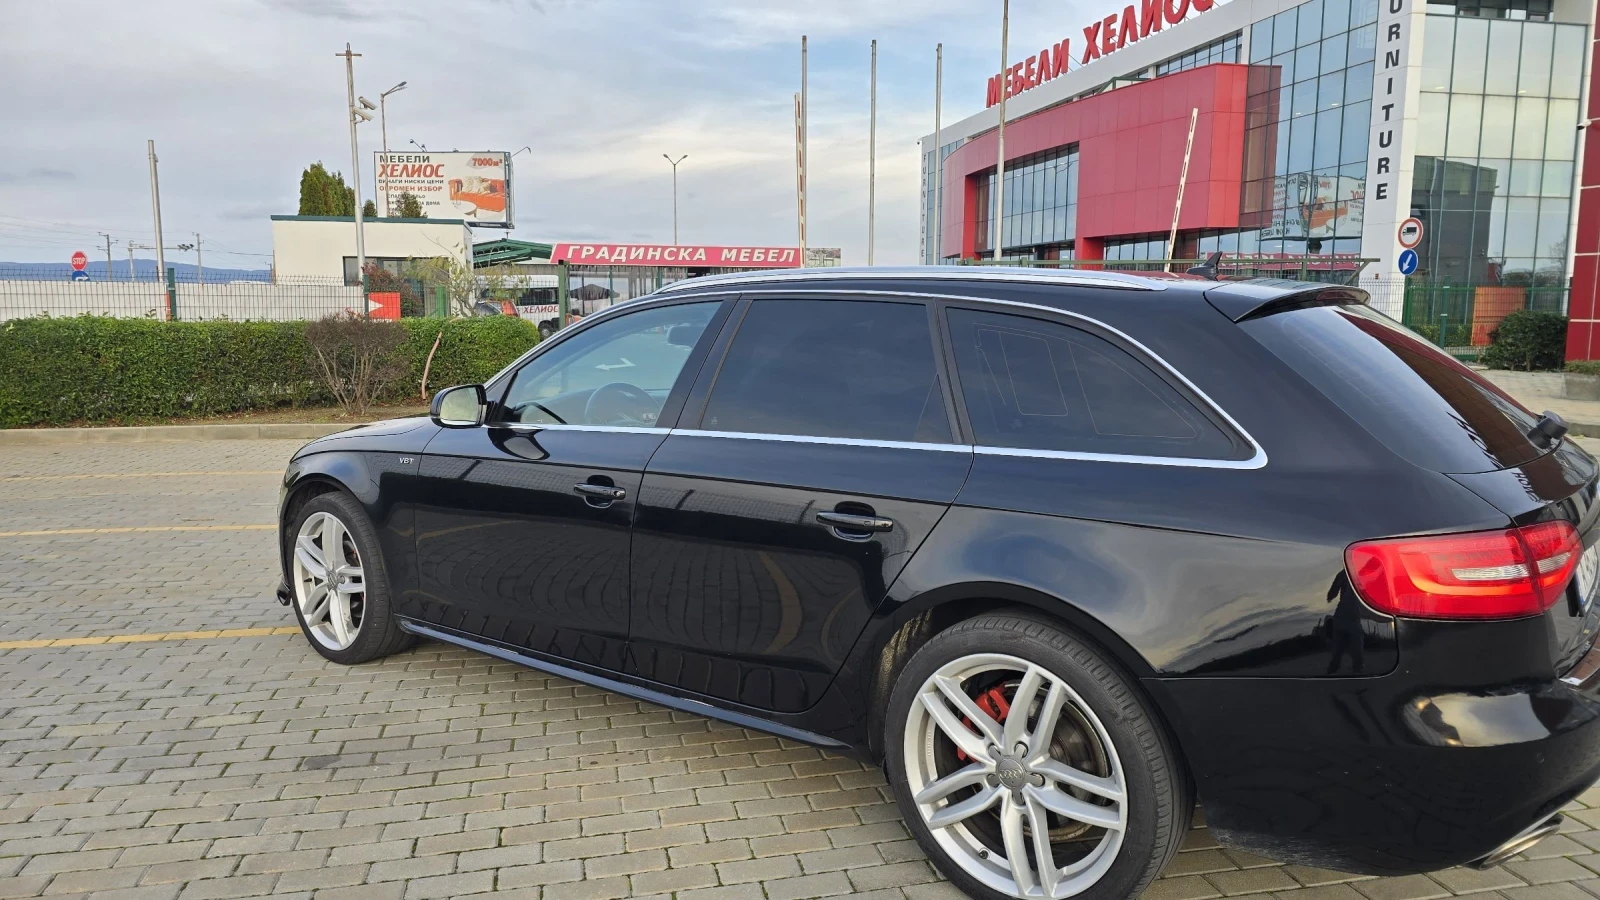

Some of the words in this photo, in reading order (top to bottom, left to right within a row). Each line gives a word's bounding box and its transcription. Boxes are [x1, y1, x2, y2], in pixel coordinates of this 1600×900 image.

[986, 38, 1070, 108] МЕБЕЛИ
[1081, 0, 1214, 65] ХЕЛИО
[379, 155, 430, 163] МЕБЕЛИ
[378, 164, 445, 178] ХЕЛИОС
[567, 245, 707, 262] ГРАДИНСКА
[720, 247, 795, 263] МЕБЕЛ
[72, 257, 86, 265] STOP
[523, 305, 559, 314] ХЕЛИОС
